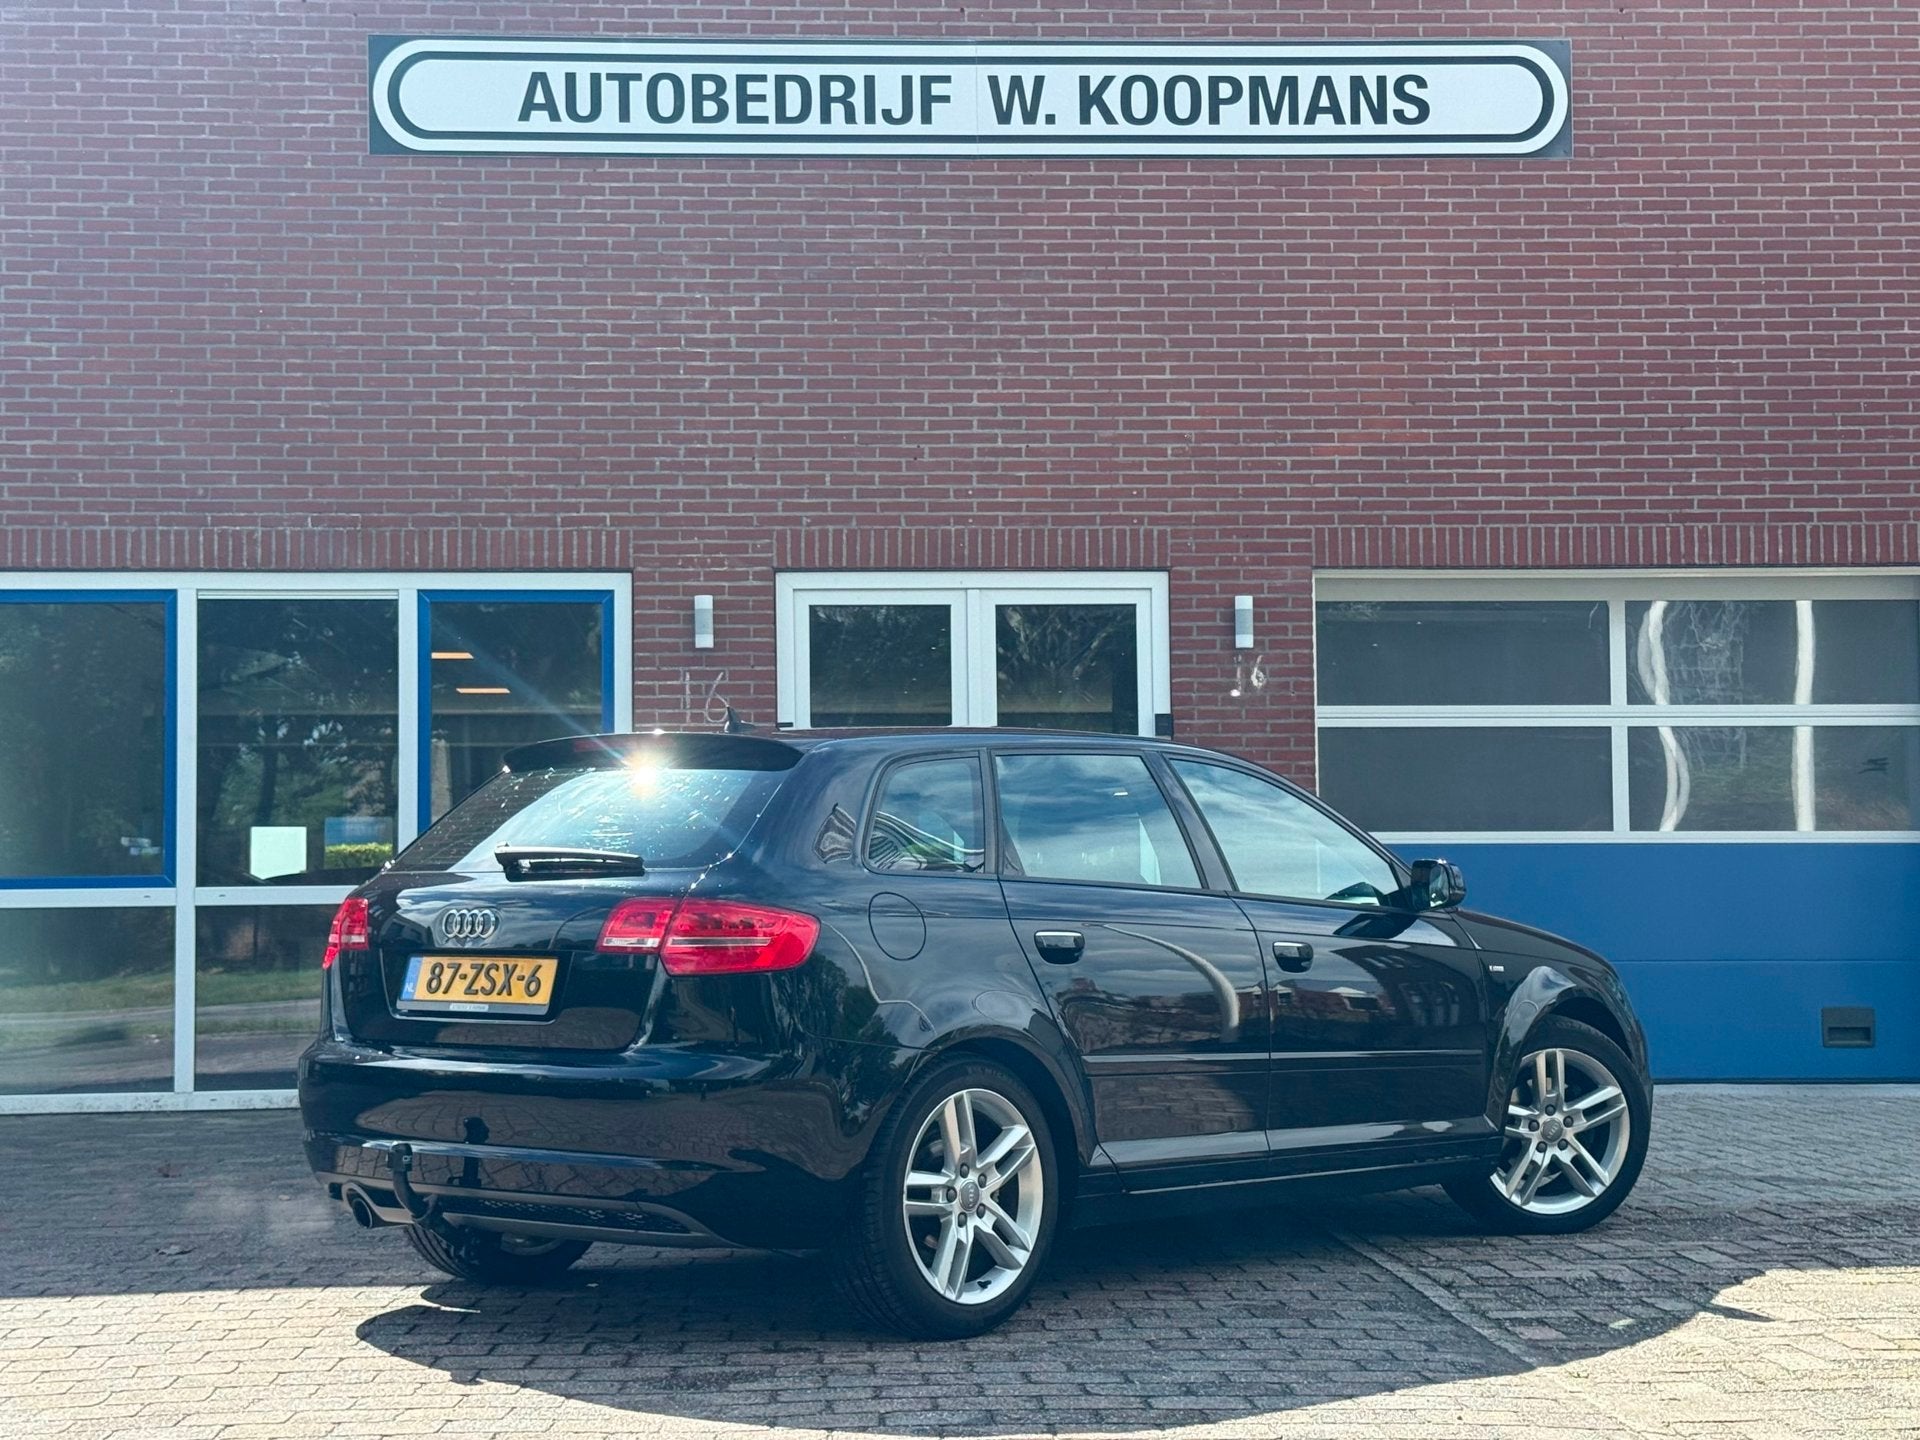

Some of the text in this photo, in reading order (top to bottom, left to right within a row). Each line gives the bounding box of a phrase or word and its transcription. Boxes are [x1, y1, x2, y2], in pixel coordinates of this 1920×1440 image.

[517, 71, 1431, 126] AUTOBEDRIJF W. KOOPMANS
[685, 671, 729, 723] 16
[404, 982, 415, 993] NL
[426, 962, 543, 997] 87-ZSX-6
